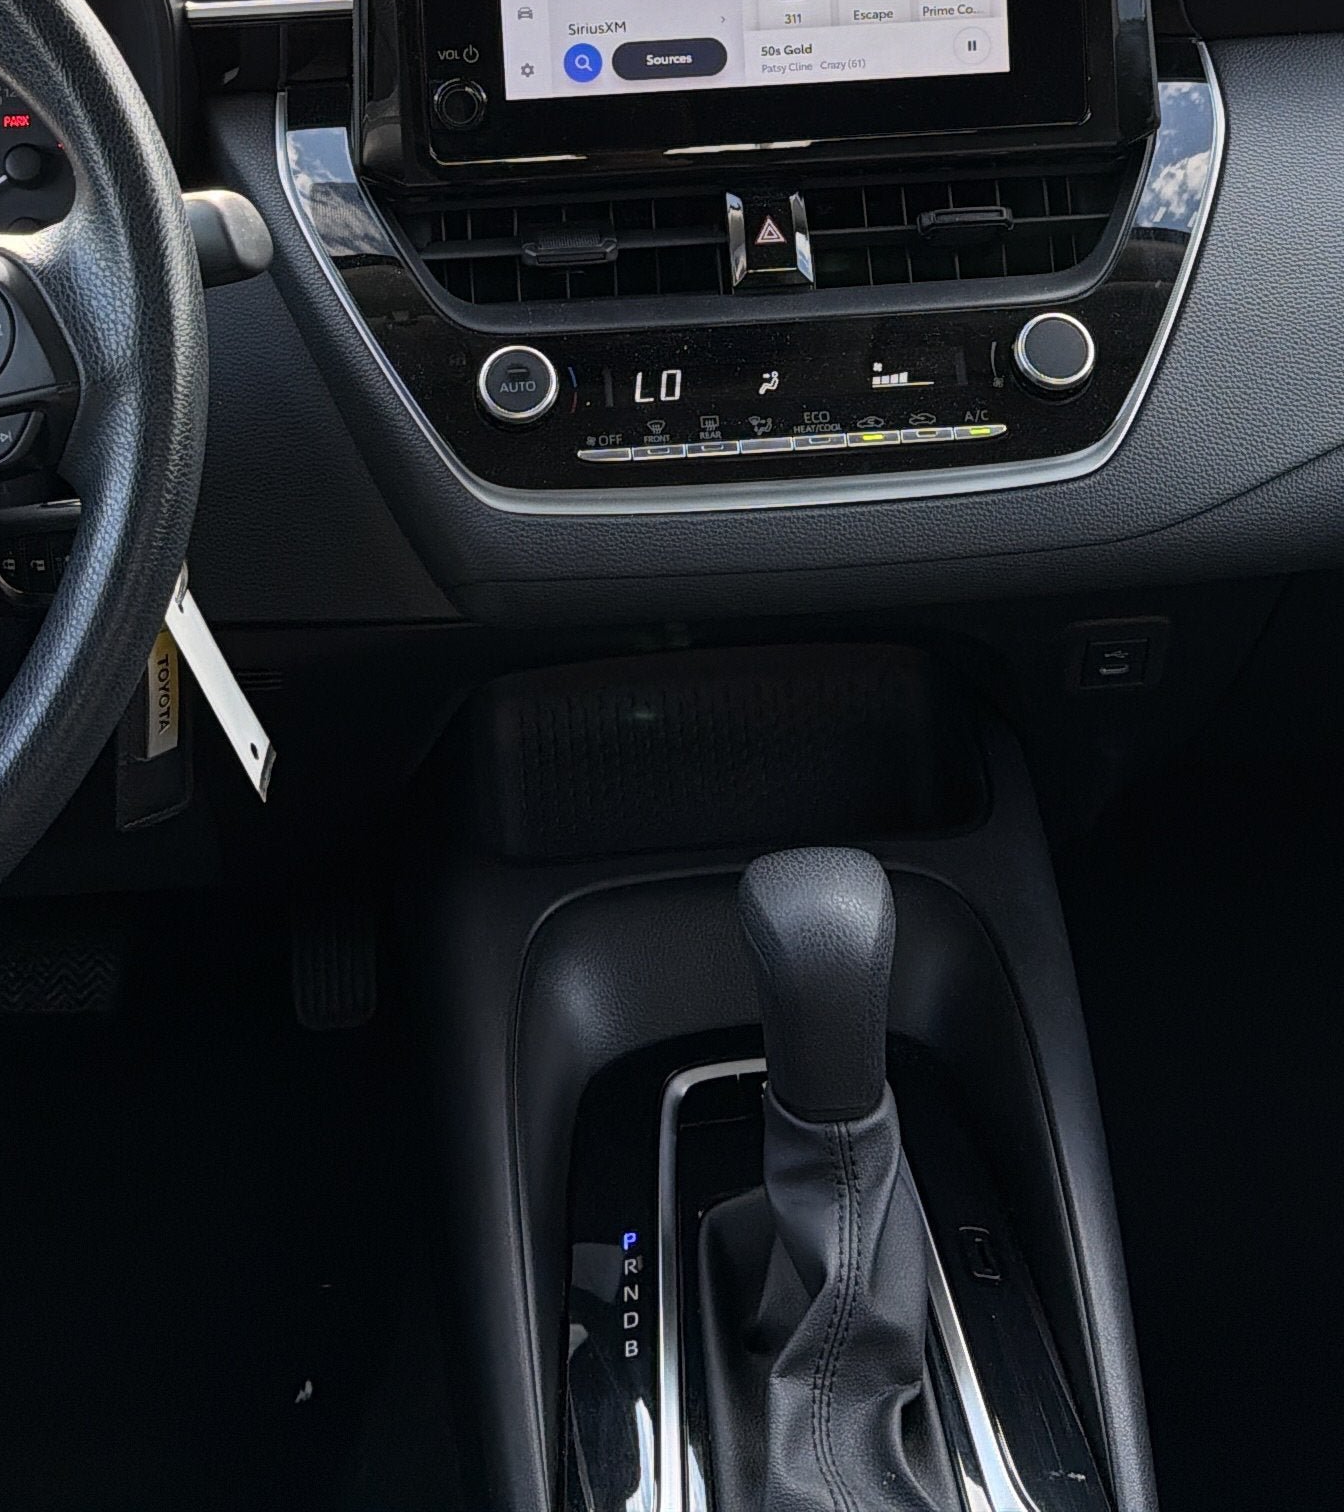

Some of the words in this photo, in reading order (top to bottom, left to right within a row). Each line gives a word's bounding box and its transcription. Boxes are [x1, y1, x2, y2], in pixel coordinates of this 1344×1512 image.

[853, 9, 894, 21] Escape
[922, 5, 955, 17] Prime
[784, 13, 802, 24] 311
[568, 21, 626, 36] SiriusXM
[437, 49, 460, 61] VOL
[761, 45, 782, 57] 50s
[784, 43, 813, 56] Gold
[646, 53, 692, 66] Sources
[761, 63, 787, 75] Patsy
[788, 62, 813, 73] Cline
[820, 59, 846, 72] Crazy
[847, 58, 866, 69] (61)
[5, 89, 17, 98] 12
[3, 115, 30, 128] PARK
[499, 380, 537, 393] AUTO
[803, 411, 831, 424] ECO
[964, 410, 989, 422] A/C
[794, 422, 843, 434] HEAT/COOL
[598, 433, 623, 446] OFF
[643, 434, 672, 444] FRONT
[700, 430, 722, 440] REAR
[157, 653, 170, 734] TOYOTA
[624, 1232, 636, 1250] P
[624, 1258, 638, 1275] R
[624, 1284, 639, 1302] N
[624, 1311, 639, 1329] D
[625, 1339, 638, 1358] B
